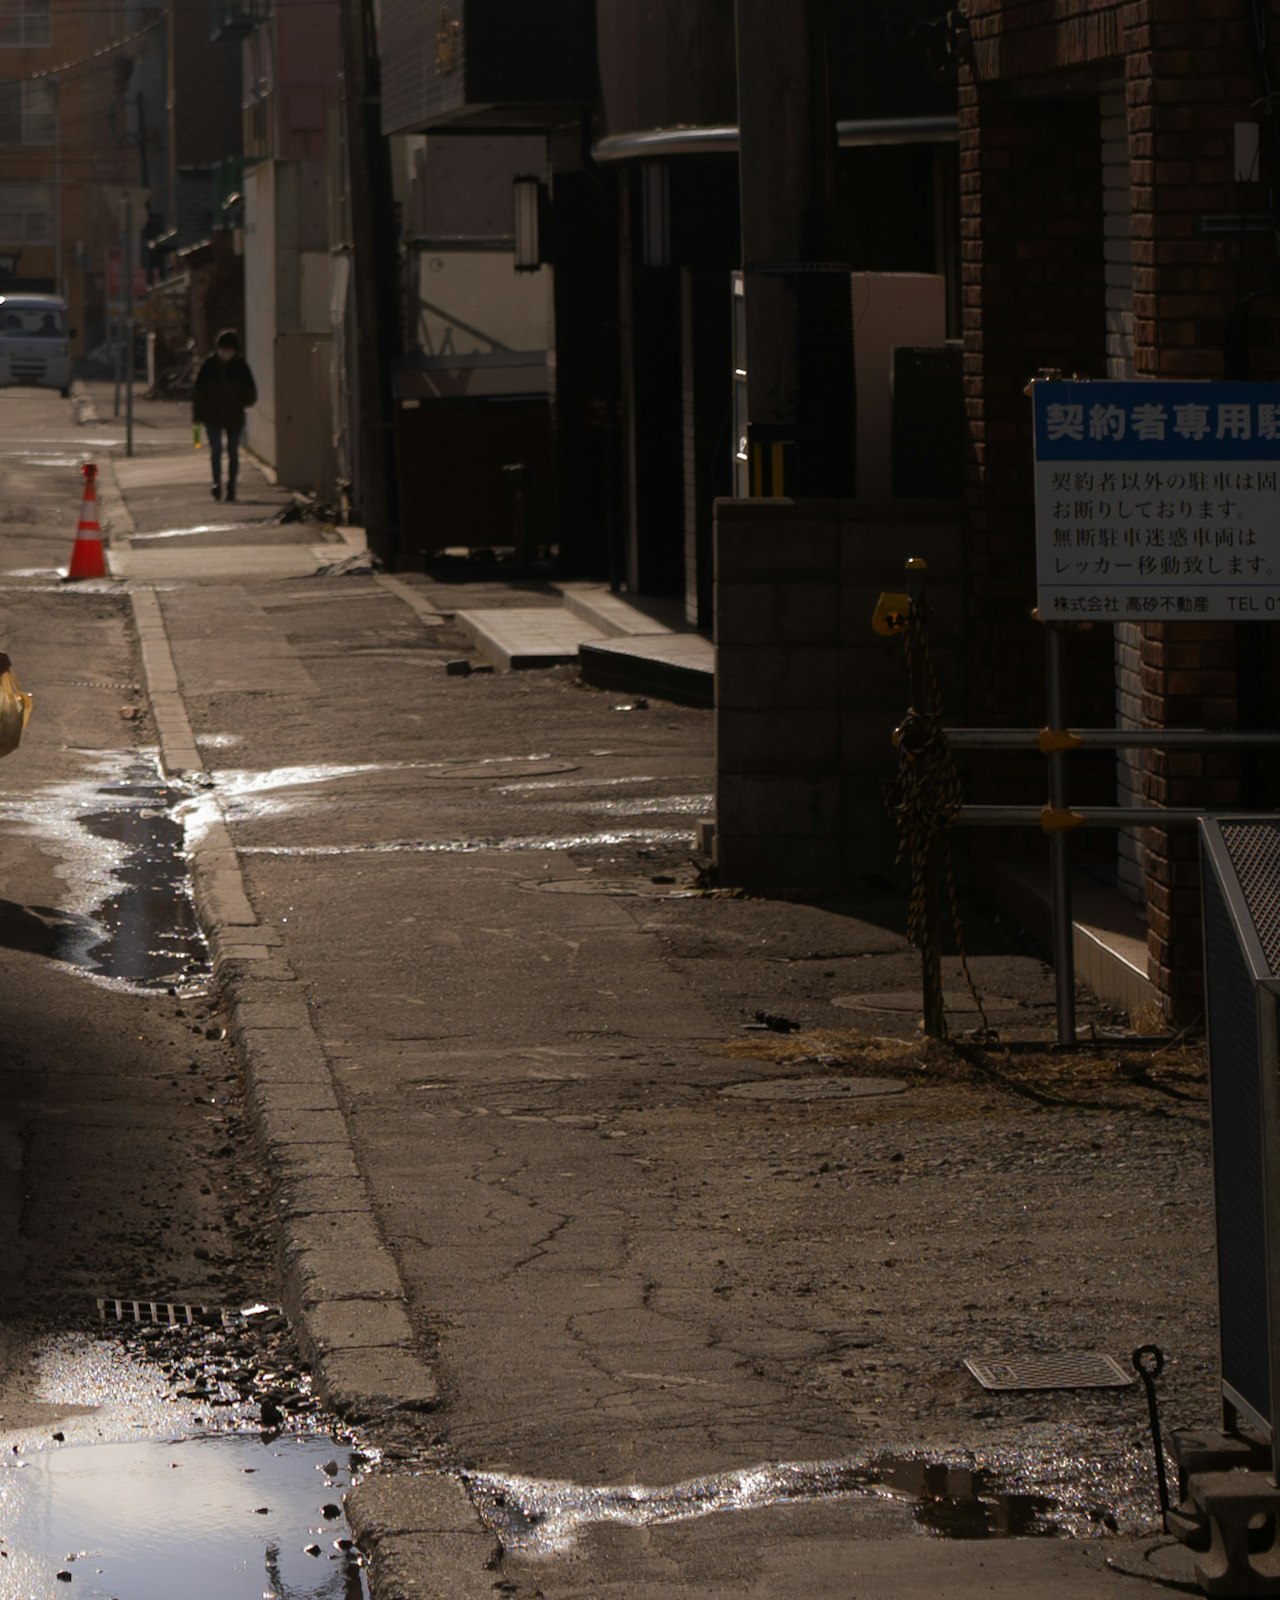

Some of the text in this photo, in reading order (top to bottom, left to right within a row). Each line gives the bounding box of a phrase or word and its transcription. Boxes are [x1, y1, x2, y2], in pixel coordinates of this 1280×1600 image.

[1051, 471, 1277, 493] 契約者以外の駐車は固
[1052, 499, 1246, 521] お断りしております。
[1052, 527, 1258, 549] 無断駐車迷惑車両は
[1054, 555, 1274, 576] レッカー移動致します。
[1053, 595, 1120, 613] 株式会社
[1125, 595, 1210, 613] 高砂不動産
[1226, 596, 1259, 612] TEL
